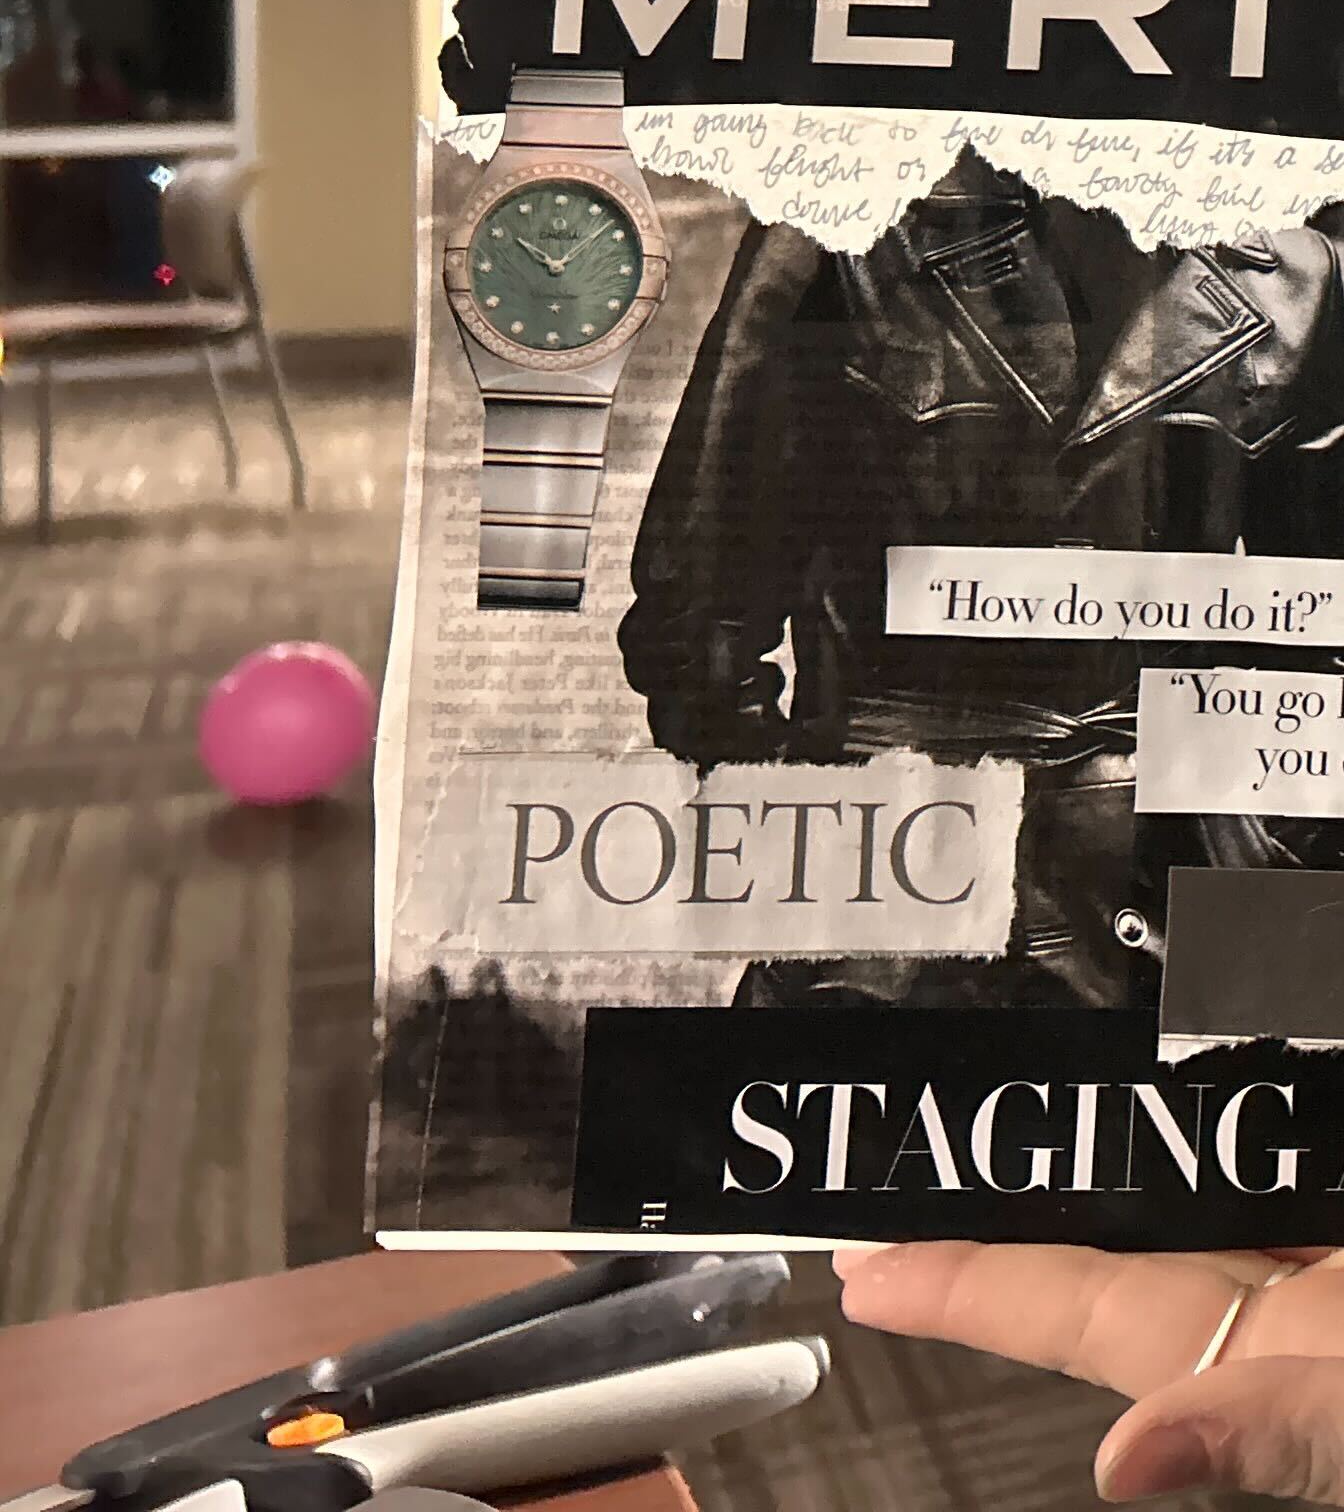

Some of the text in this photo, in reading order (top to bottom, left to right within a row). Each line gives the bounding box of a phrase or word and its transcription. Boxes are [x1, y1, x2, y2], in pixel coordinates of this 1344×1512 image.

[1274, 146, 1297, 169] a
[1053, 582, 1104, 626] do
[1115, 601, 1191, 639] you
[1204, 588, 1256, 632] do
[1275, 691, 1327, 734] go
[1252, 746, 1331, 791] you
[498, 798, 978, 906] POETIC
[722, 1080, 1311, 1194] STAGING
